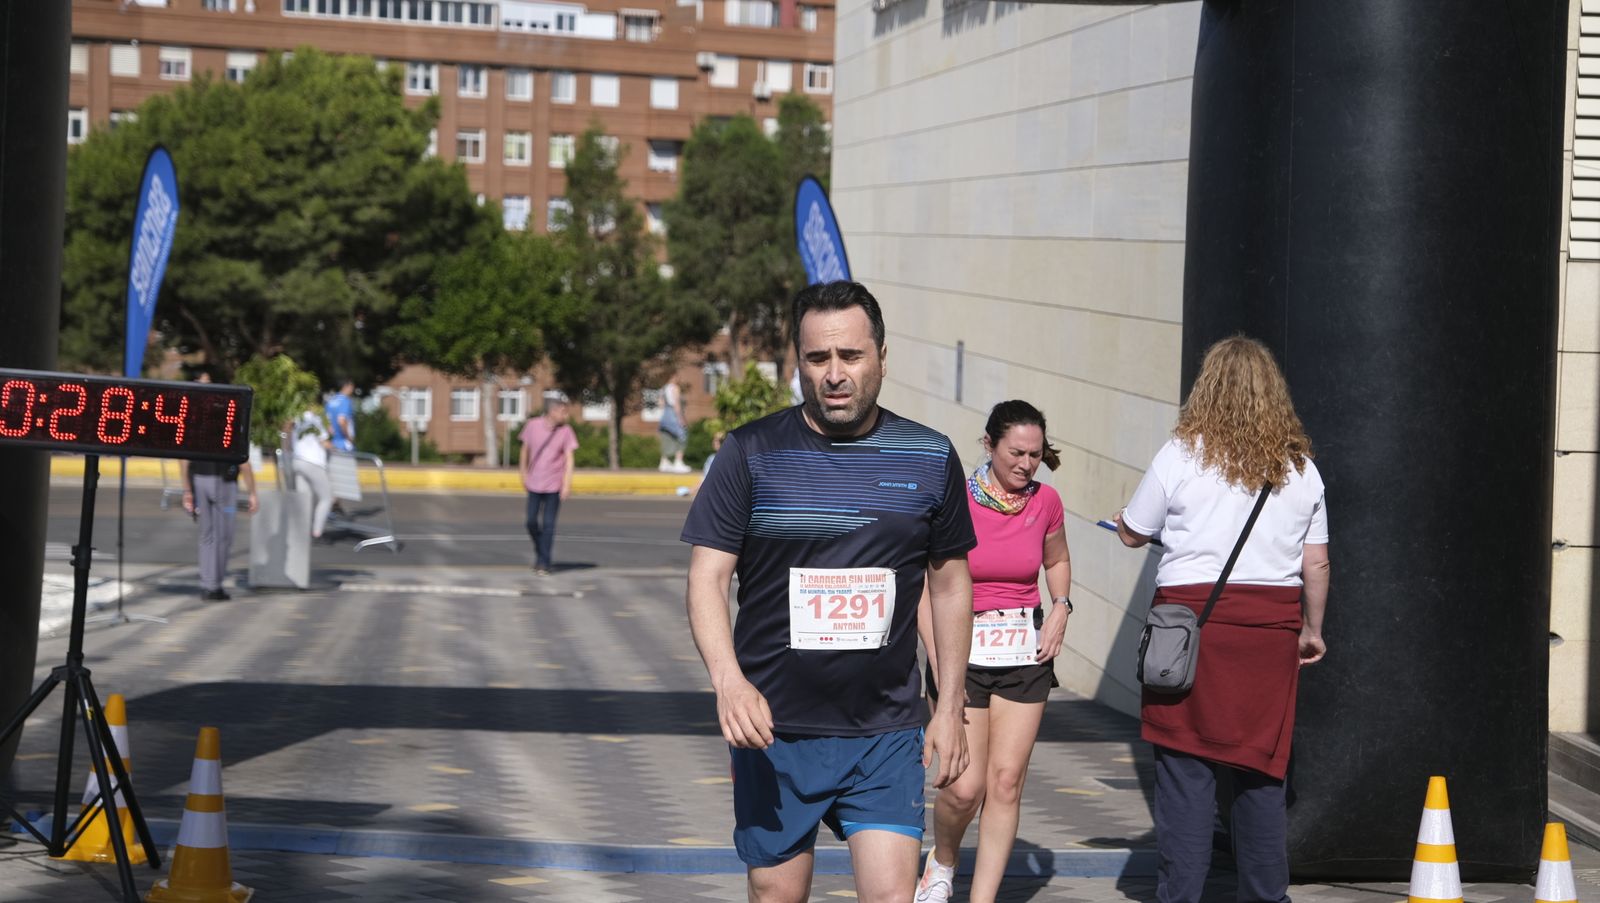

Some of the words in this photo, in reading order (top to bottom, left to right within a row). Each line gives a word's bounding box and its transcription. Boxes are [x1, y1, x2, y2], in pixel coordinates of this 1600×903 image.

[808, 575, 847, 584] CARRERA
[849, 575, 863, 583] SIN
[865, 574, 886, 583] HUMO
[807, 593, 885, 619] 1291
[833, 622, 866, 631] ANTONIO
[975, 628, 1028, 647] 1277
